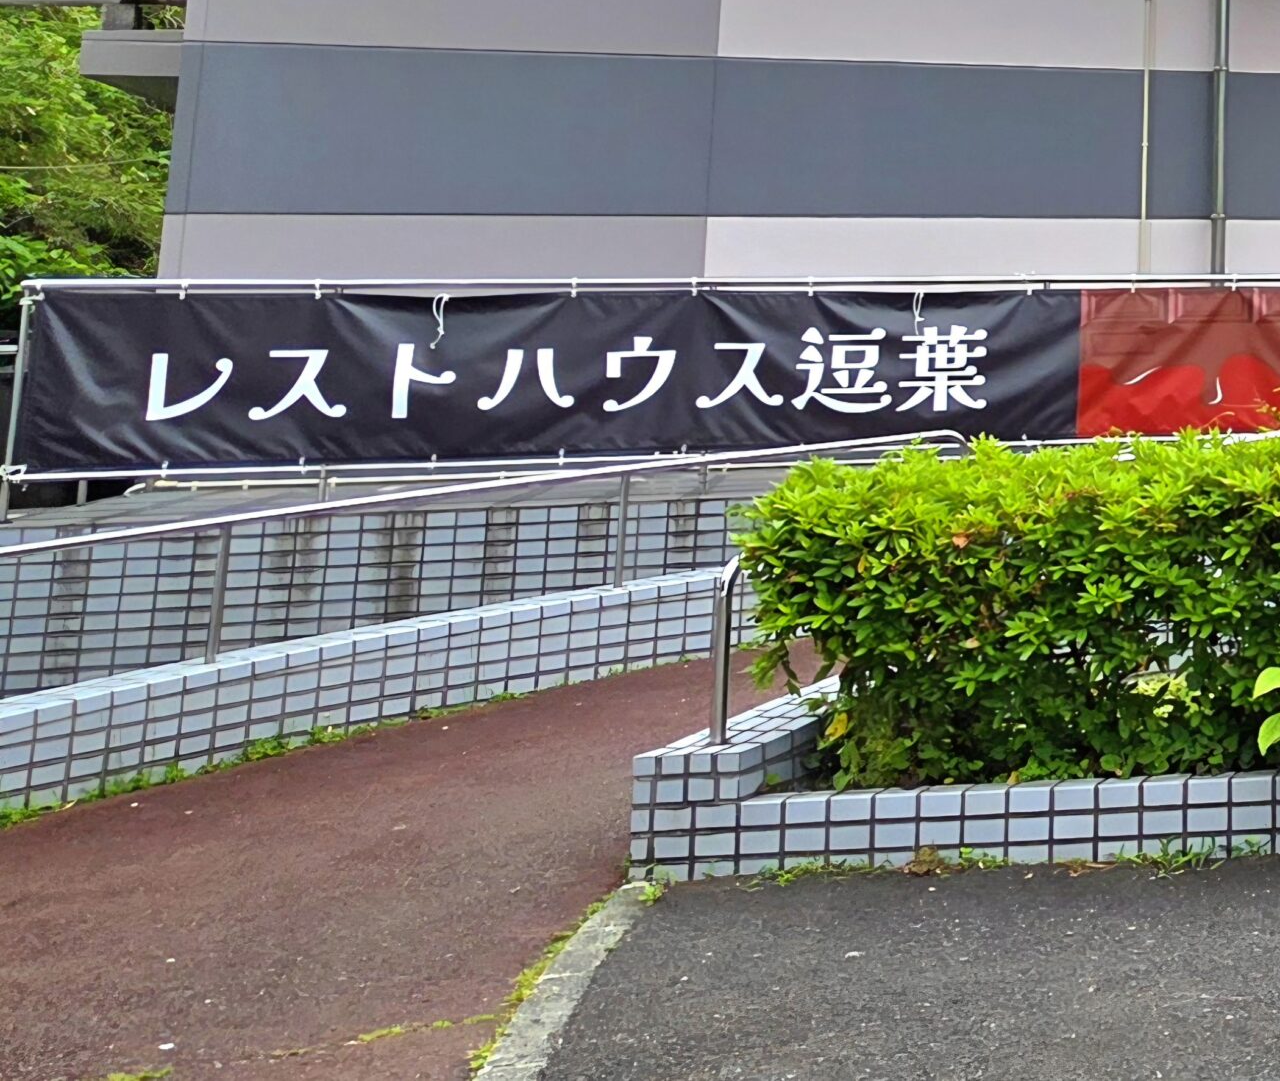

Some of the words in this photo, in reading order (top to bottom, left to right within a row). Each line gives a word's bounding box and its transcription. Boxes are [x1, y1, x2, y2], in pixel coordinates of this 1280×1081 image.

[144, 326, 988, 421] レストハウス逗葉
